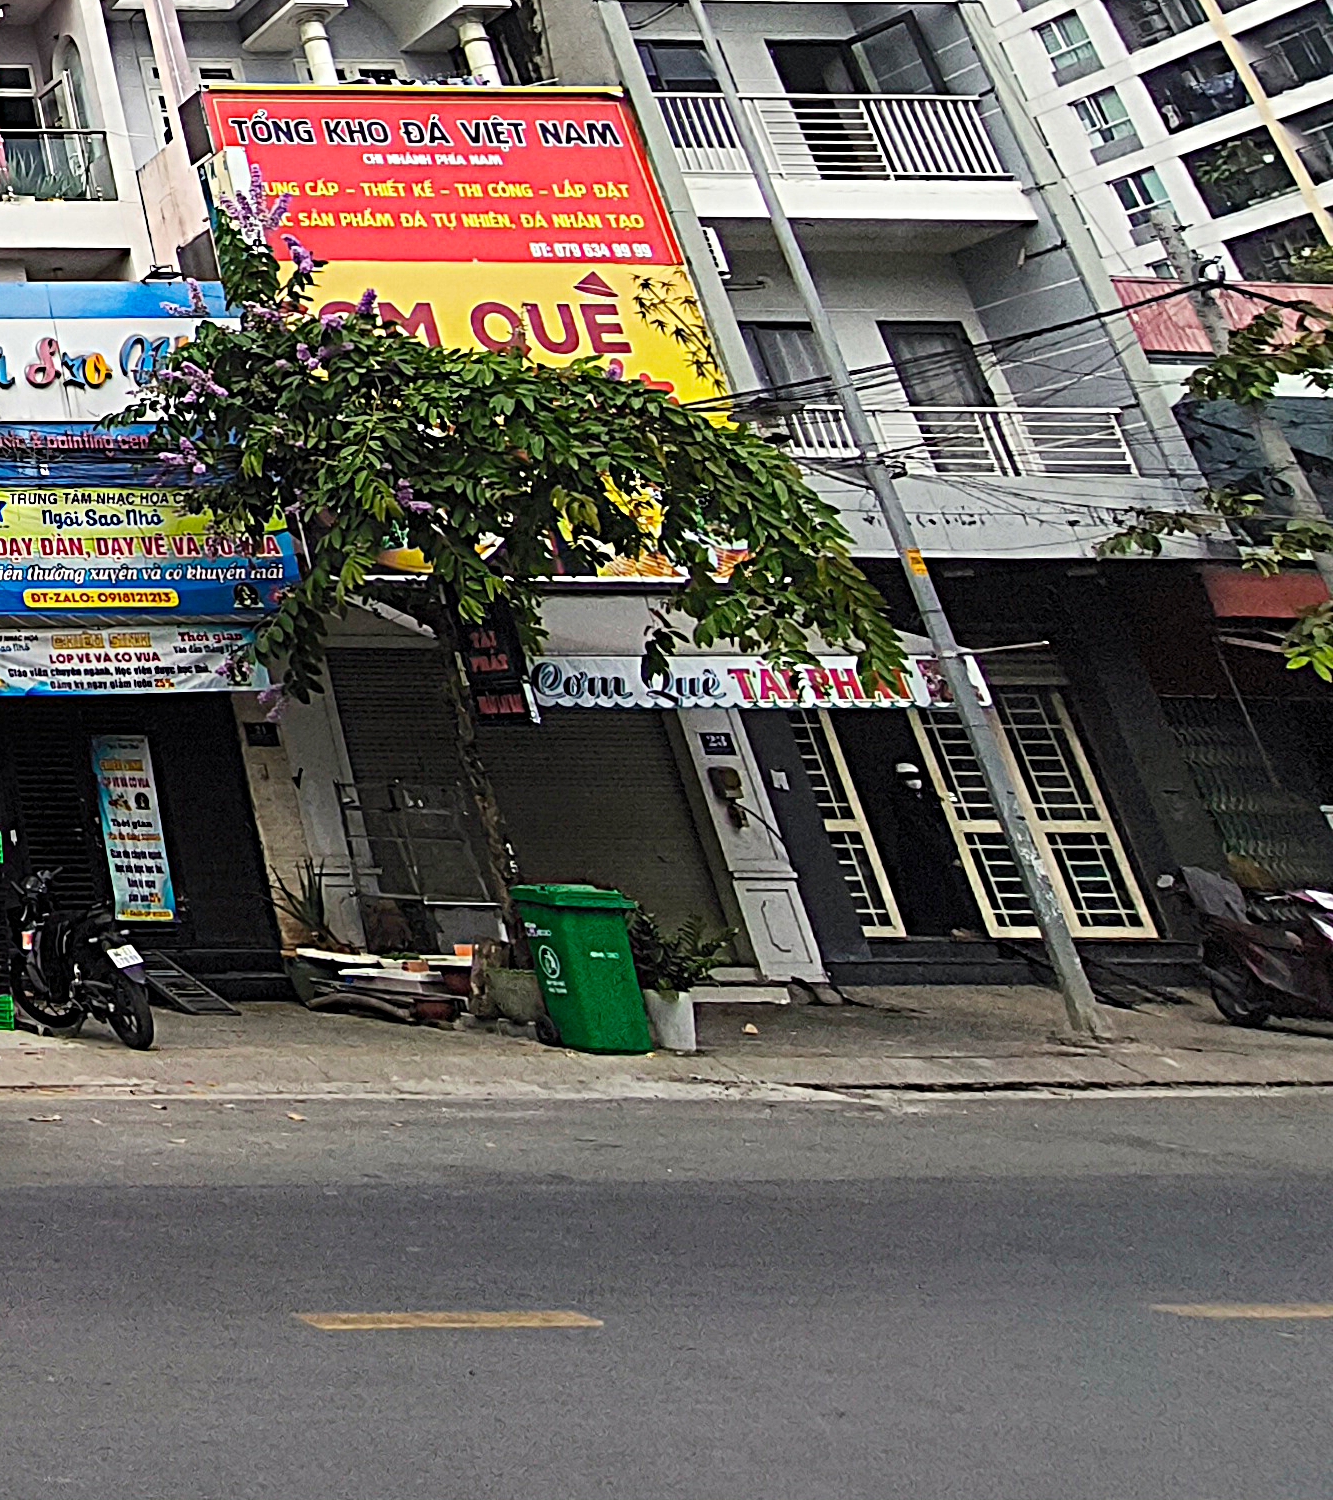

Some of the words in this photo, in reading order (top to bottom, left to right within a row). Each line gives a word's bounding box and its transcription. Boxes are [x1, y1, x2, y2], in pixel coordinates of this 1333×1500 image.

[230, 110, 314, 145] TỔNG
[324, 119, 390, 145] KHO
[401, 114, 453, 147] ĐÁ
[458, 116, 526, 151] VIỆT
[536, 119, 624, 148] NAM
[470, 153, 503, 166] NAM
[263, 181, 299, 196] UNG
[305, 178, 339, 196] CẤP
[361, 177, 406, 197] THIẾT
[412, 178, 434, 197] KẾ
[454, 182, 482, 198] THI
[488, 180, 533, 198] CÔNG
[552, 178, 586, 198] LẮP
[593, 181, 629, 200] ĐẶT
[300, 208, 335, 227] SẢN
[340, 207, 394, 228] PHẨM
[400, 209, 427, 228] ĐÁ
[431, 211, 458, 230] TỰ
[462, 210, 515, 229] NHIÊN,
[521, 210, 548, 229] ĐÁ
[553, 211, 602, 229] NHÂN
[607, 213, 645, 232] TẠO
[10, 493, 57, 505] TRUNG
[63, 489, 92, 505] TÂM
[95, 493, 135, 507] NHẠC
[140, 493, 169, 507] HỌA
[42, 509, 83, 529] Ngôi
[85, 509, 123, 527] Sao
[126, 508, 164, 526] Nhỏ
[39, 532, 91, 559] ĐÀN,
[96, 535, 134, 563] DẠY
[140, 532, 168, 558] VẼ
[172, 531, 202, 557] VÀ
[26, 563, 86, 585] thường
[90, 564, 138, 583] xuyên
[142, 562, 161, 580] và
[165, 564, 183, 580] có
[186, 562, 246, 583] khuyến
[30, 592, 94, 604] ĐT-ZALO:
[97, 592, 172, 604] 0918121213
[135, 651, 161, 662] VUA
[534, 661, 633, 700] Cơm
[706, 735, 727, 747] 23
